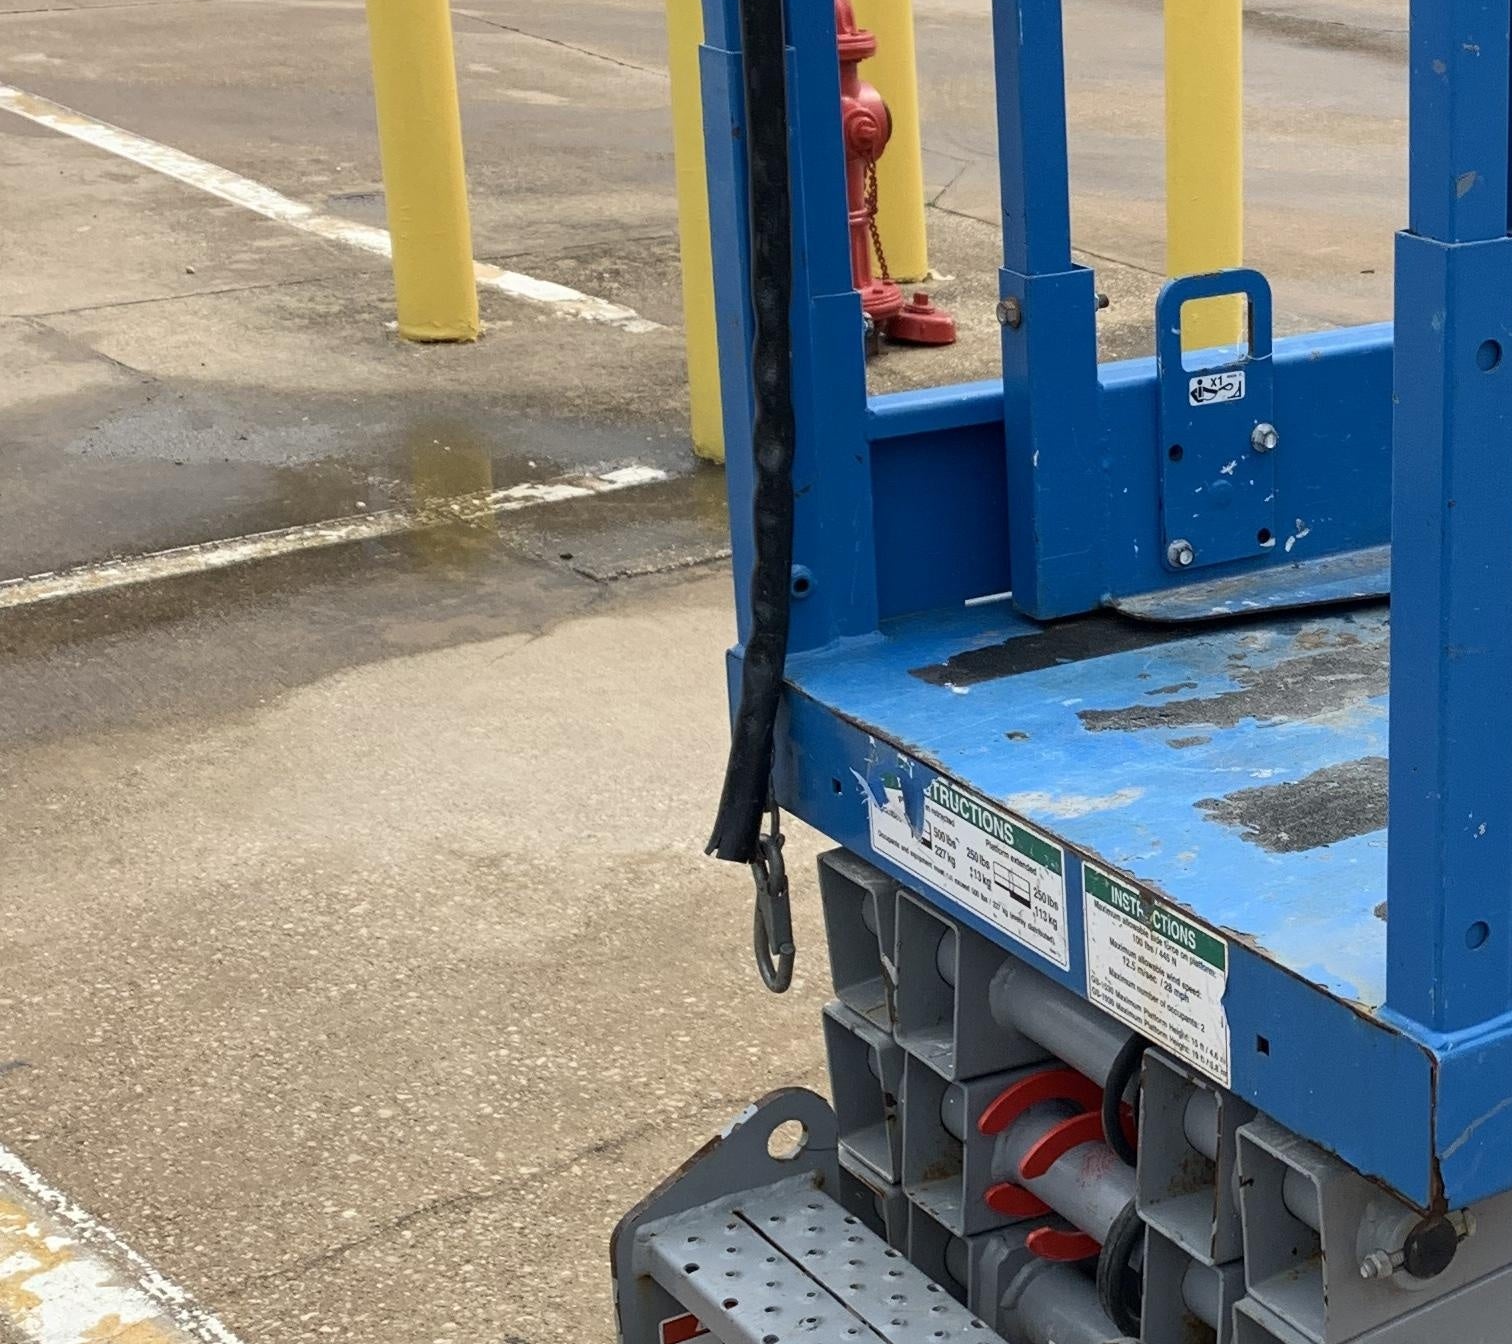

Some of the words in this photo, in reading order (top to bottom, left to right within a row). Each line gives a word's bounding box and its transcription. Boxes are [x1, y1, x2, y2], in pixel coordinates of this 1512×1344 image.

[933, 824, 945, 843] 500
[945, 832, 957, 850] lbs
[946, 851, 956, 870] kg
[965, 846, 979, 864] 250
[978, 853, 990, 871] lbs
[981, 873, 992, 891] kg
[1032, 885, 1047, 905] 250
[1046, 911, 1058, 932] kg
[1121, 954, 1136, 972] 12.5
